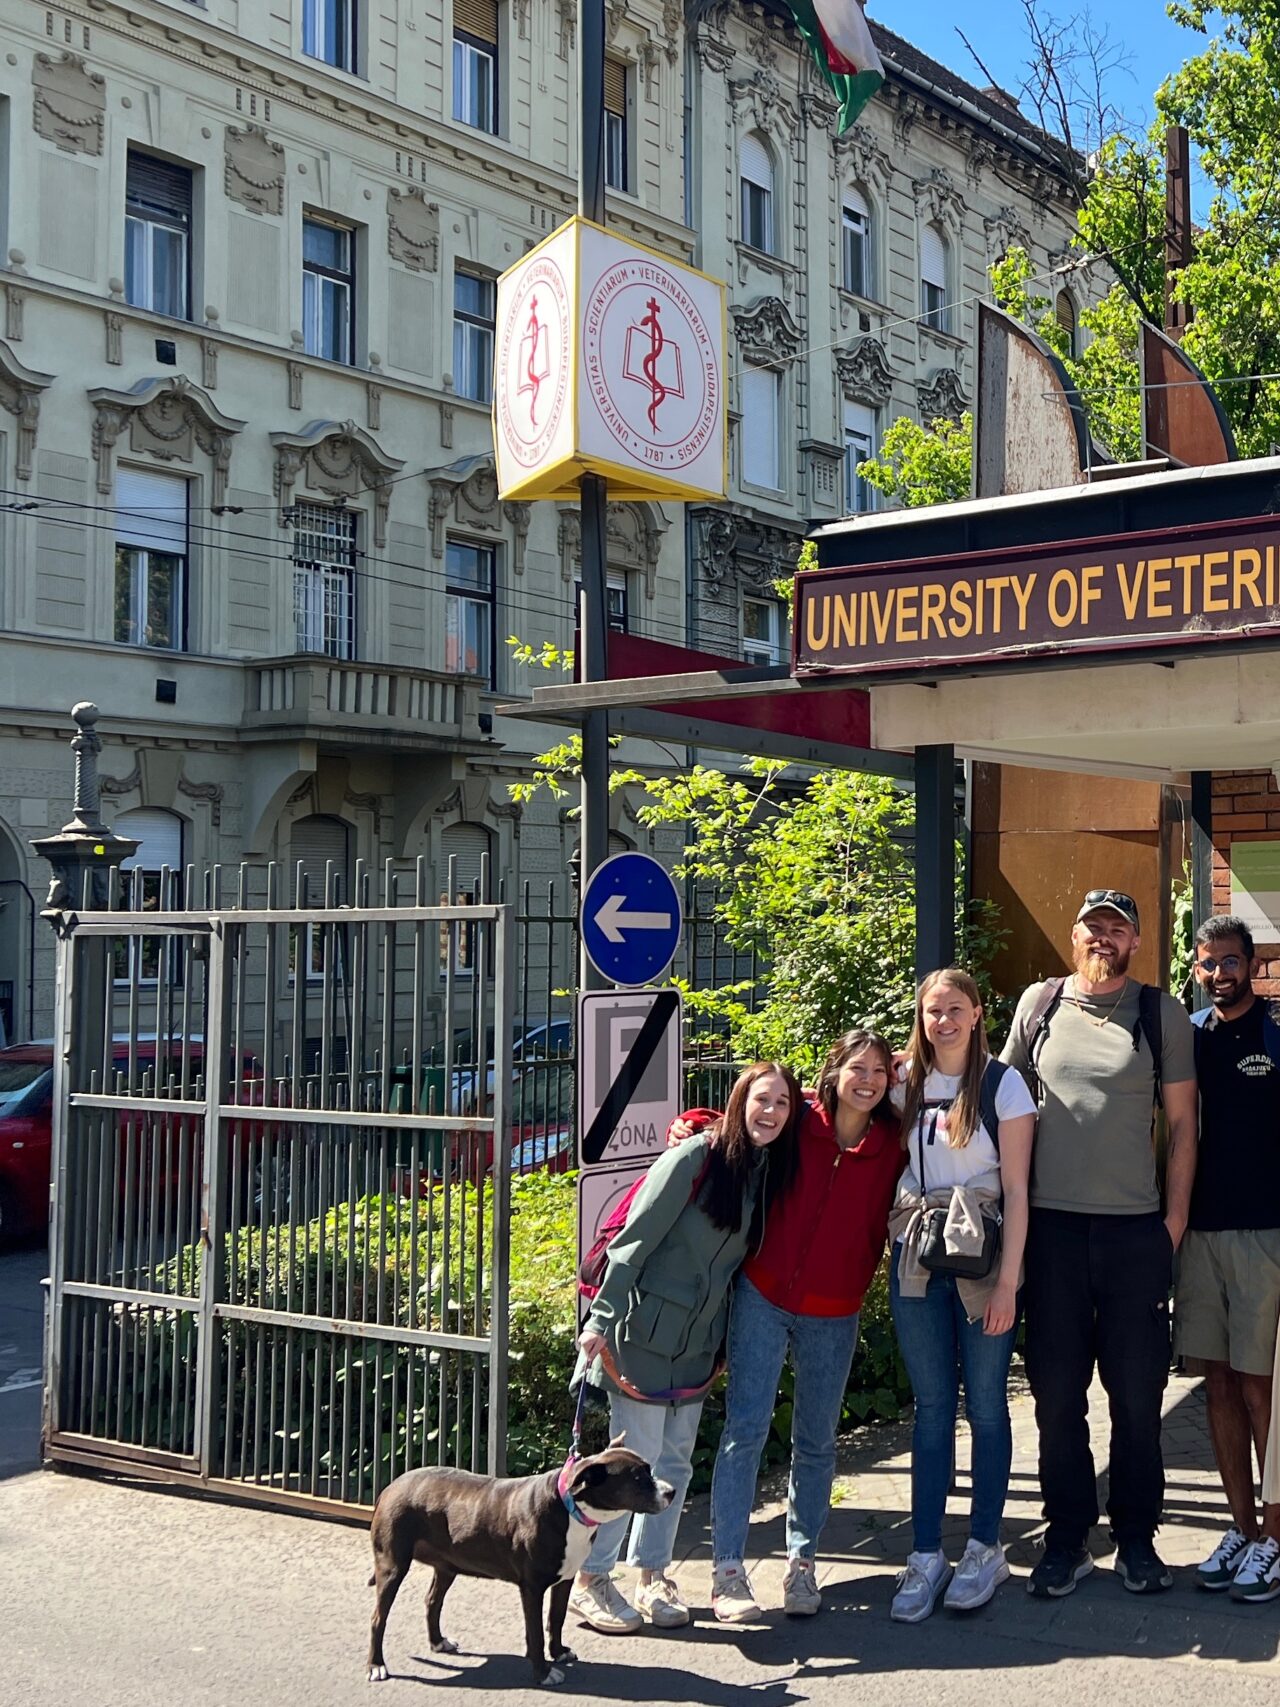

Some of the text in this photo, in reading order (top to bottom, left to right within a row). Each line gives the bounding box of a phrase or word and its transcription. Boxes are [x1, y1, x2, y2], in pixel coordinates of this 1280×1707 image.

[589, 267, 716, 463] UNIVERSITAS SCIENTIARUM VETERINARIARUM BUDAPESTINENSIS 1787
[807, 573, 1037, 651] UNIVERSITY
[1048, 565, 1104, 629] OF
